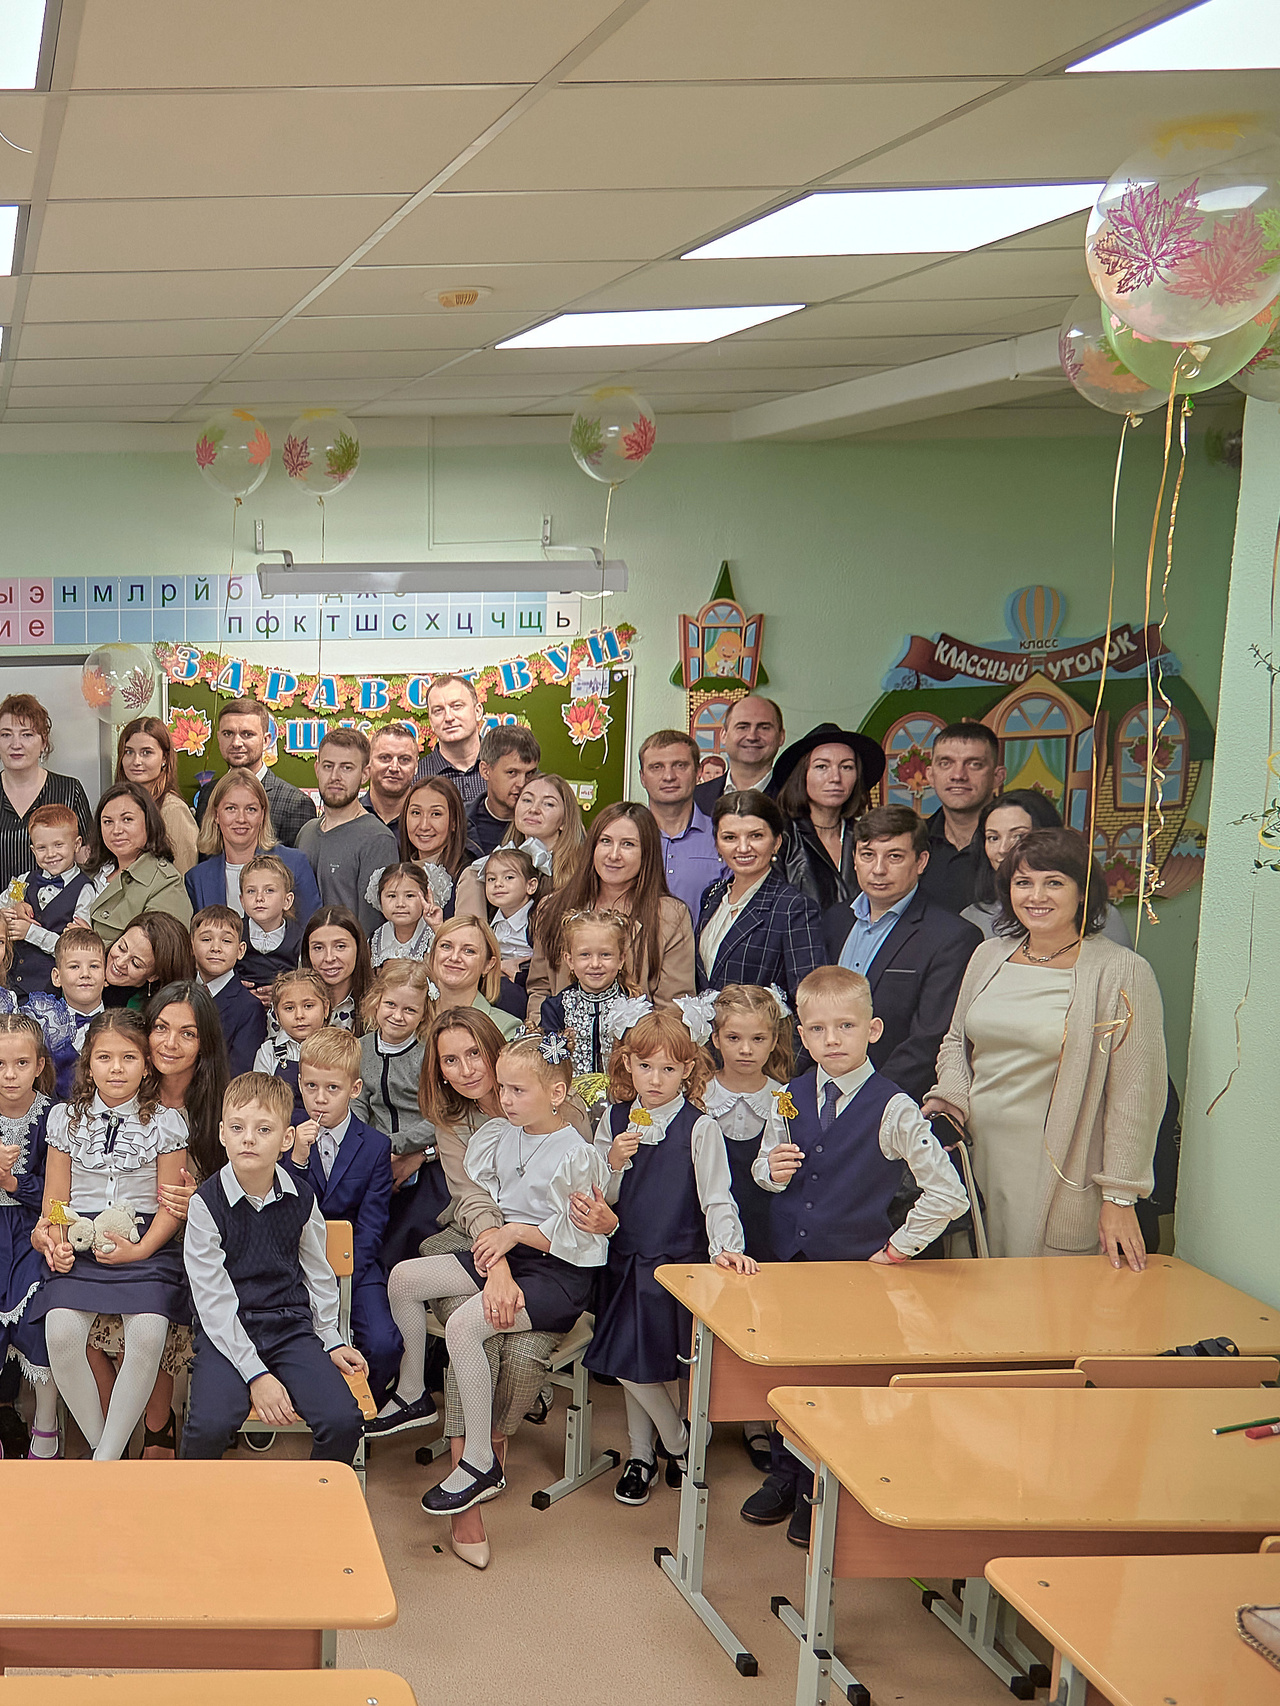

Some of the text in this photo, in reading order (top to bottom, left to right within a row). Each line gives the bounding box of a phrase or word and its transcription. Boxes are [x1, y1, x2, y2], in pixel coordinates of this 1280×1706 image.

[29, 585, 45, 604] э
[62, 585, 77, 603] н
[93, 584, 113, 603] м
[127, 584, 144, 602] л
[161, 583, 177, 608] р
[194, 577, 210, 601] й
[228, 576, 243, 601] б
[28, 619, 45, 638] е
[228, 616, 242, 634] п
[255, 610, 280, 639] ф
[294, 615, 307, 633] к
[326, 615, 341, 632] т
[356, 614, 378, 632] ш
[392, 613, 407, 632] с
[425, 612, 440, 631] х
[457, 612, 473, 634] ц
[491, 611, 505, 630] ч
[519, 611, 543, 633] щ
[556, 611, 571, 629] ь
[934, 631, 1138, 683] КЛАССНЫЙ УГОЛОК
